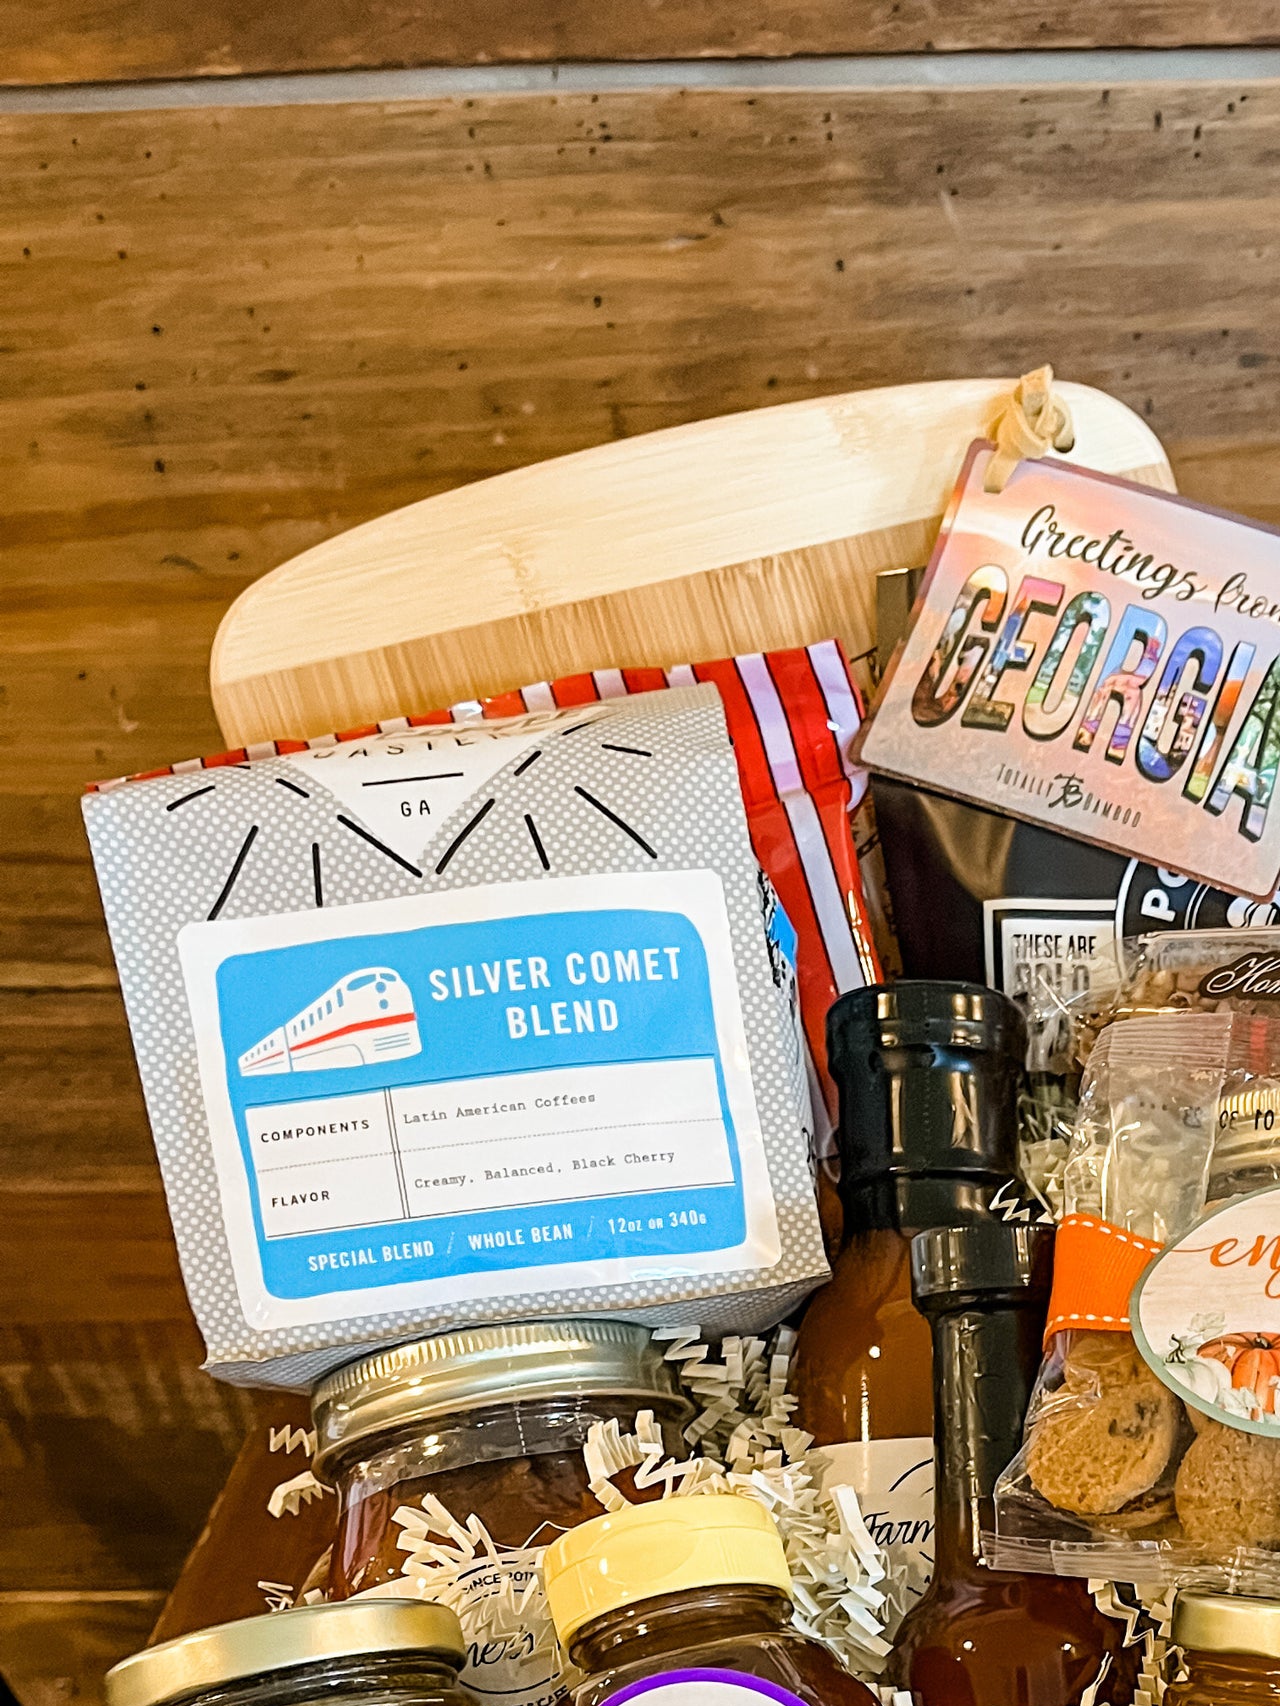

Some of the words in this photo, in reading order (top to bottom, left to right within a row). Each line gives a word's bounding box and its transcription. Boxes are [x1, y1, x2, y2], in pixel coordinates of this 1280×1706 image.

[1021, 504, 1207, 601] Greetings
[400, 800, 431, 817] GA
[996, 763, 1053, 798] TOTALLY
[1083, 792, 1142, 828] BAMBOO
[1012, 934, 1062, 959] THESE
[428, 956, 549, 1000] SILVER
[566, 947, 681, 987] COMET
[506, 999, 619, 1040] BLEND
[403, 1108, 448, 1125] Latin
[455, 1100, 527, 1121] American
[534, 1092, 596, 1113] Coffees
[260, 1119, 370, 1144] COMPONENTS
[413, 1171, 475, 1194] Creamy,
[484, 1162, 562, 1184] Balanced,
[572, 1156, 615, 1174] Black
[623, 1148, 676, 1171] Cherry
[270, 1189, 331, 1209] FLAVOR
[467, 1229, 525, 1252] WHOLE
[529, 1222, 574, 1246] BEAN
[307, 1245, 377, 1272] SPECIAL
[381, 1238, 435, 1264] BLEND
